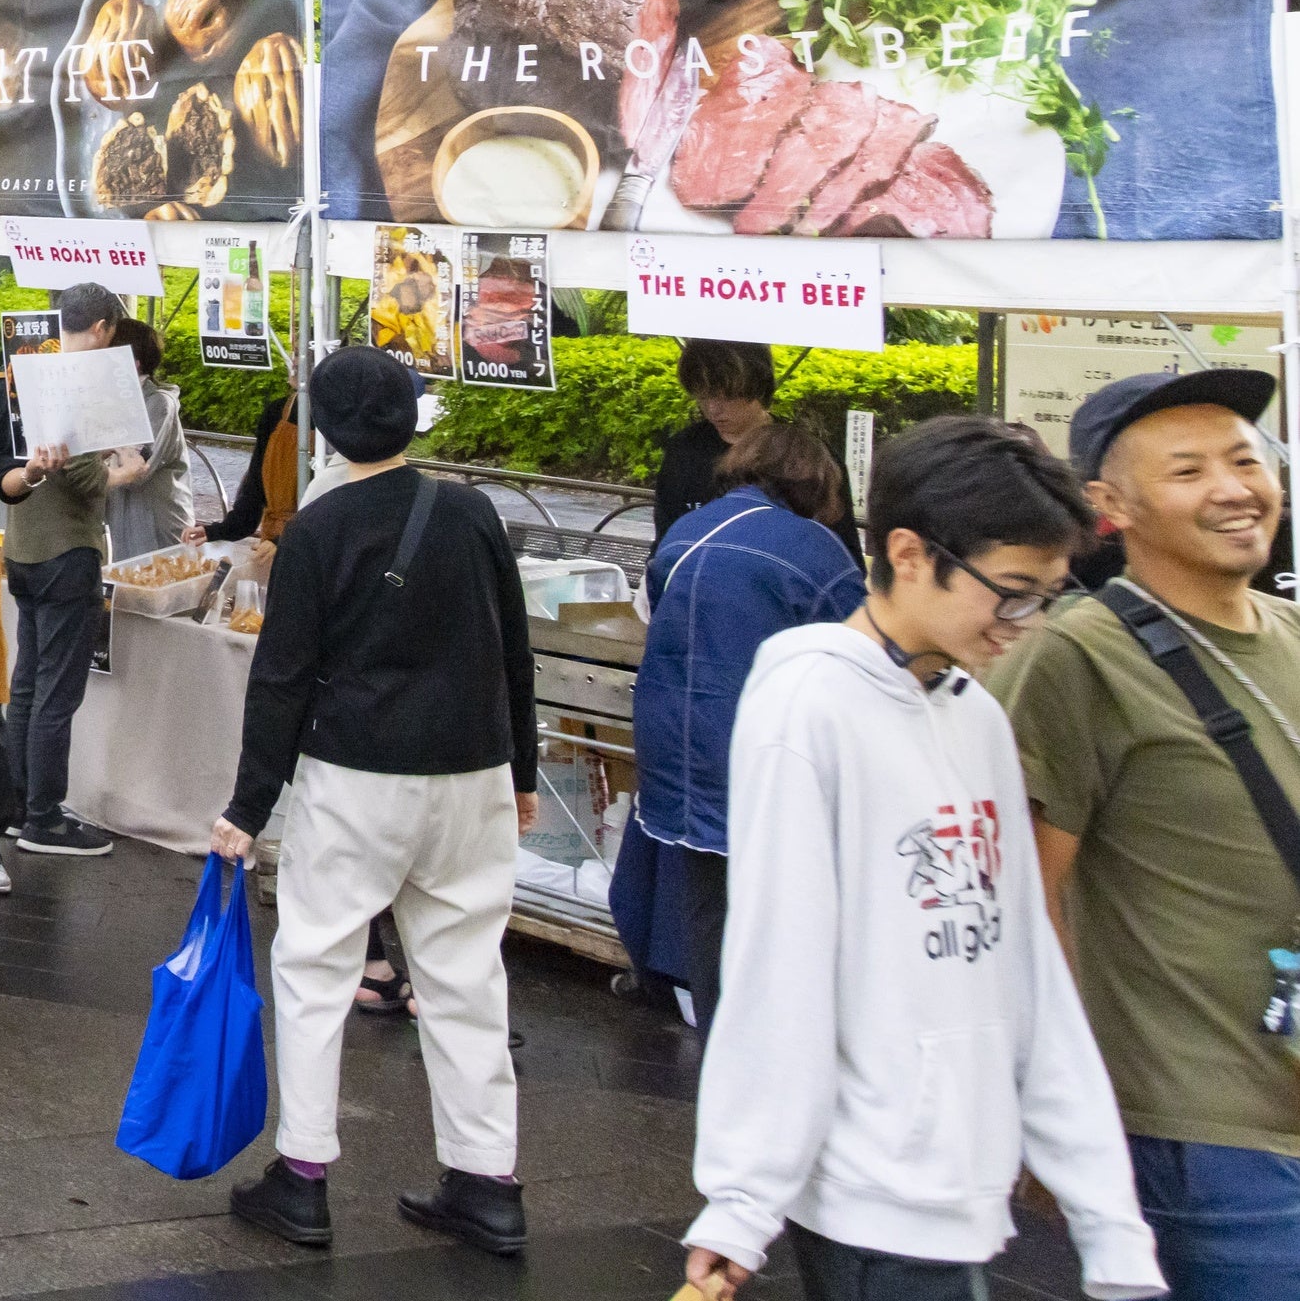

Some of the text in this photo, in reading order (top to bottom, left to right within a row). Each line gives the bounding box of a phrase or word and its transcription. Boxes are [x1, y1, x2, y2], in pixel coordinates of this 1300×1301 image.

[415, 9, 1092, 82] THE ROAST BEEF
[64, 38, 159, 102] PIE
[46, 178, 89, 192] BEEF
[205, 237, 240, 247] KAMIKATZ
[509, 236, 545, 259] 極柔
[15, 245, 147, 267] THE ROAST BEEF
[205, 250, 216, 260] IPA
[718, 267, 764, 276] ロースト
[639, 275, 867, 308] THE ROAST BEEF
[15, 320, 50, 336] 金賞受賞
[530, 264, 547, 377] ローストビーフ
[205, 344, 229, 360] 800
[228, 352, 241, 360] YEN
[416, 358, 430, 368] YEN
[466, 360, 528, 379] 1,000 YEN
[925, 919, 959, 962] all
